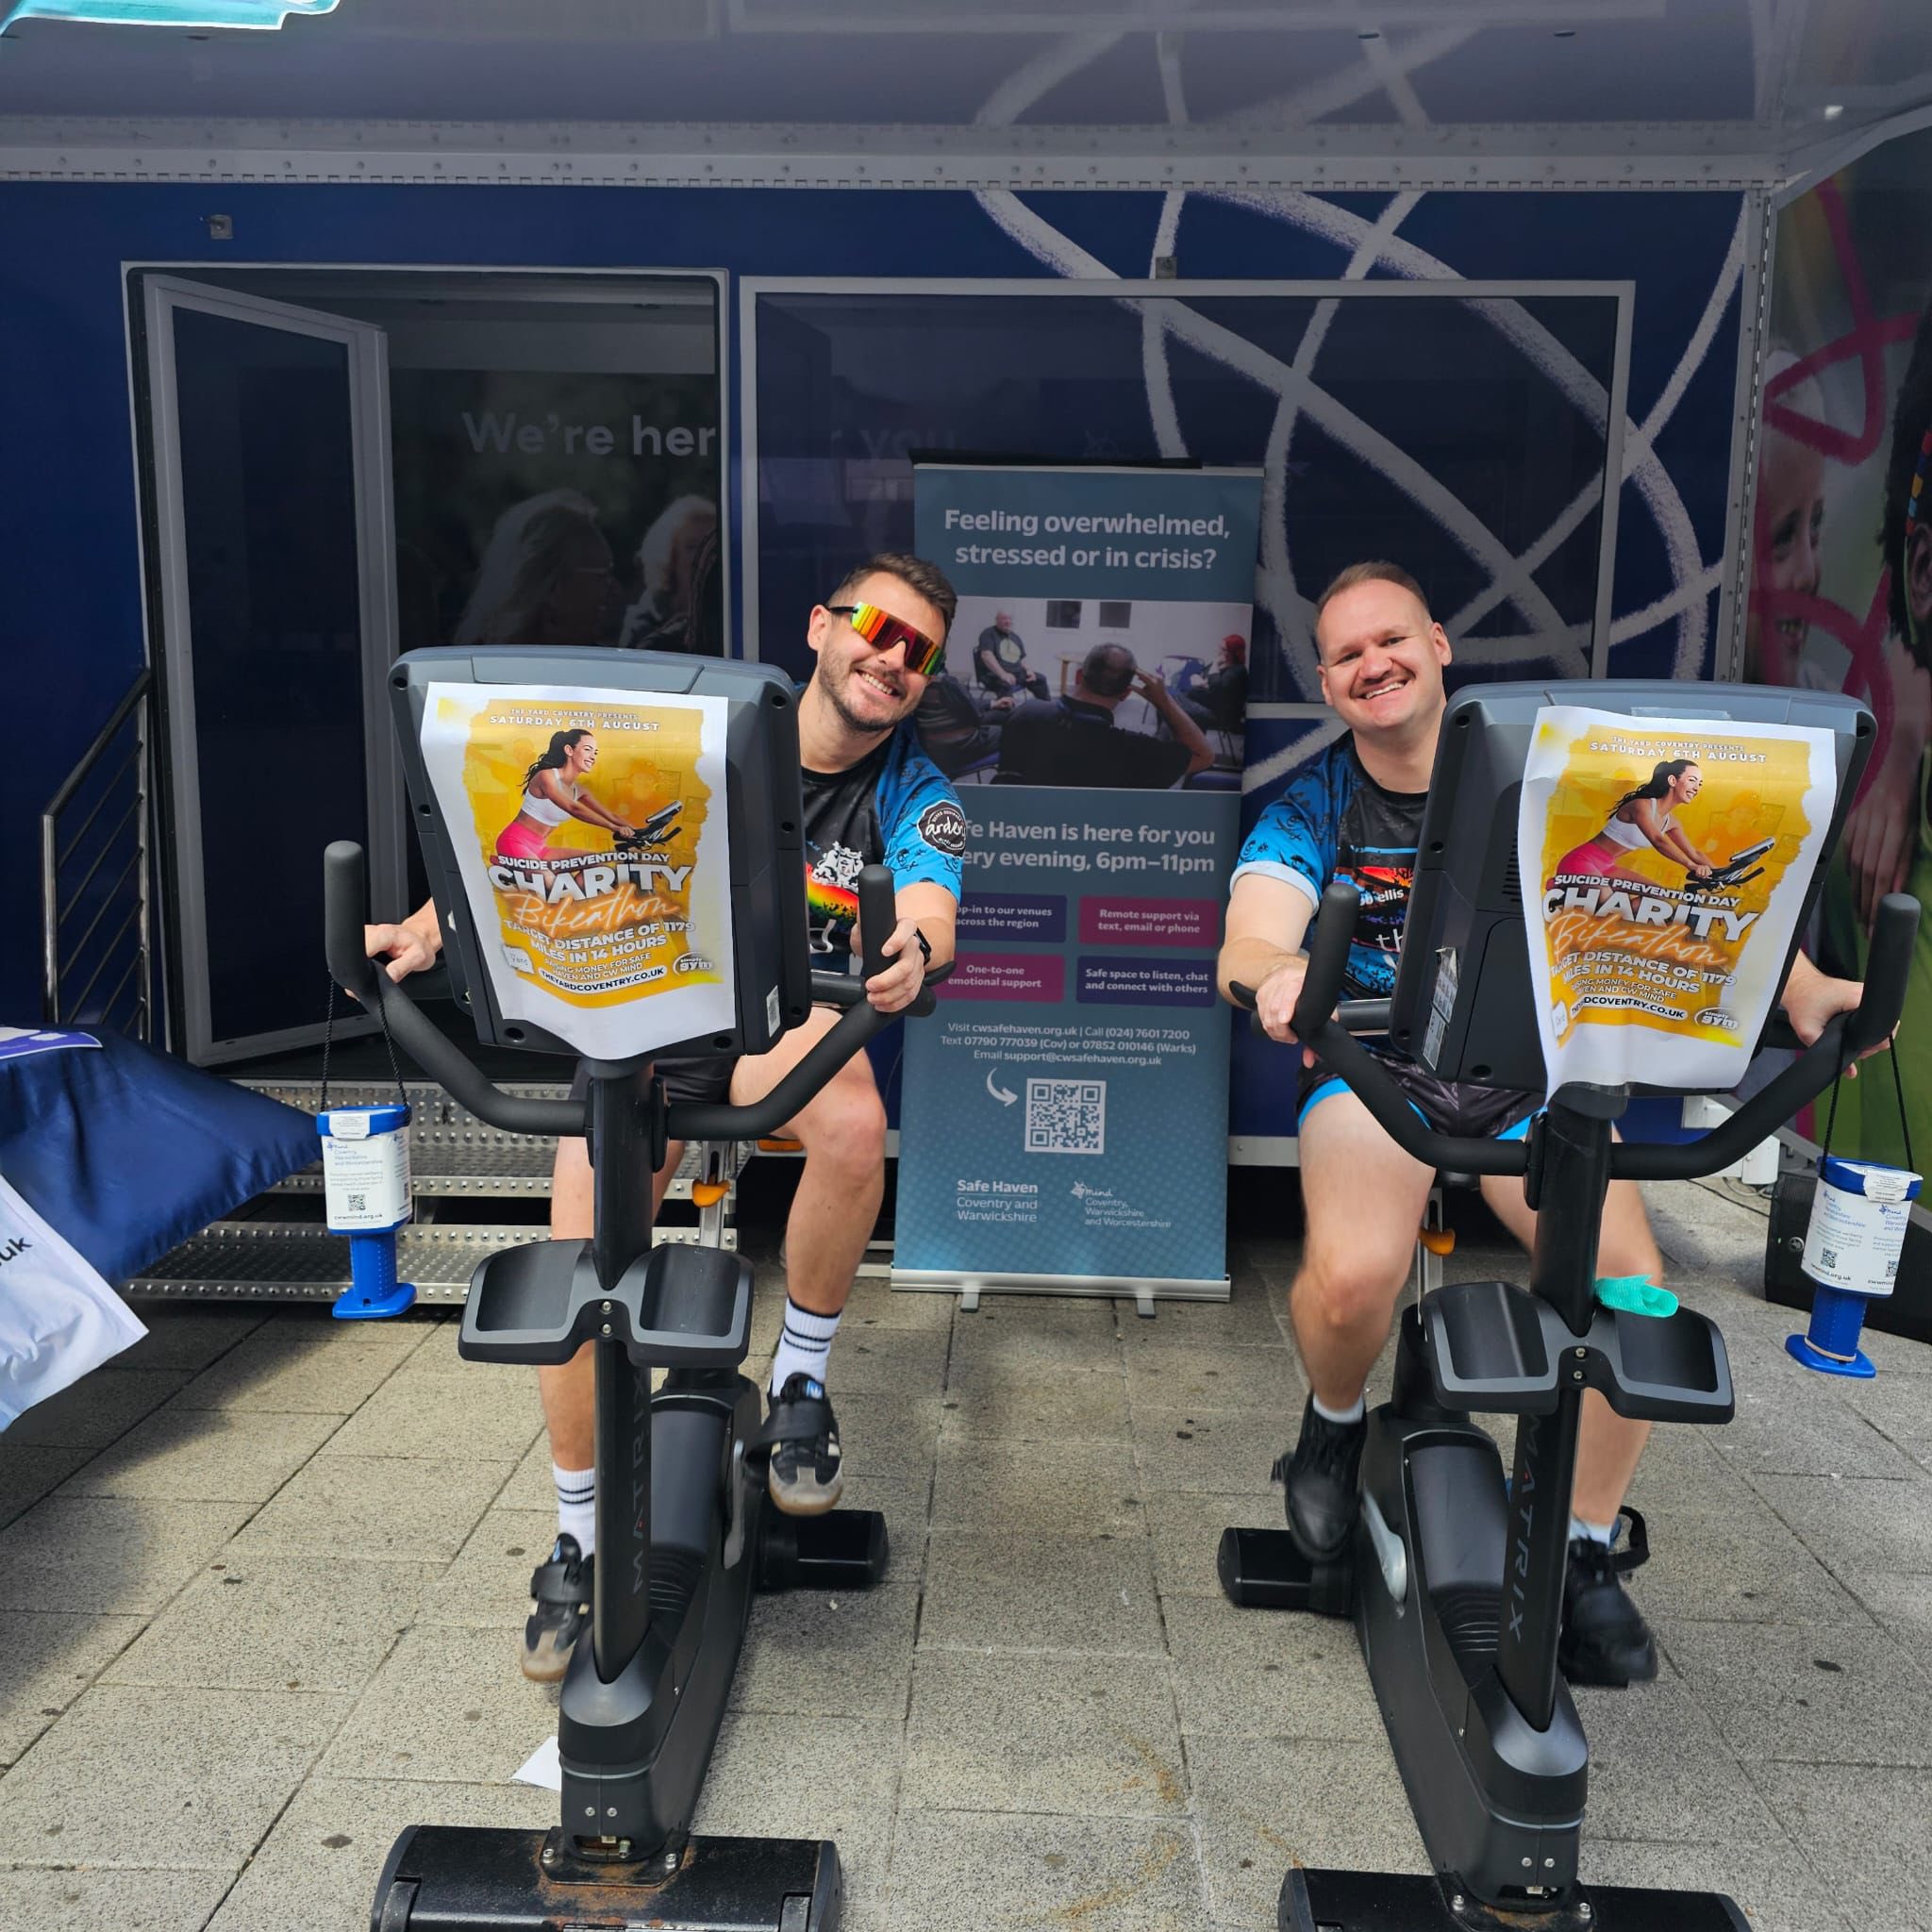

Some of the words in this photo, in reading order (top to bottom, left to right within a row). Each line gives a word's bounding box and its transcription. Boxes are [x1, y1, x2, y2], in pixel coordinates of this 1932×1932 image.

[633, 415, 716, 458] her
[944, 509, 1039, 536] Feeling
[1044, 511, 1230, 539] overwhelmed,
[956, 544, 1066, 566] stressed
[1072, 548, 1100, 566] or
[1106, 545, 1129, 566] in
[1135, 547, 1217, 570] crisis?
[490, 715, 562, 726] SATURDAY
[569, 719, 595, 728] 6TH
[603, 721, 659, 731] AUGUST
[1590, 741, 1666, 757] SATURDAY
[1674, 750, 1700, 758] 6TH
[1707, 753, 1767, 763] AUGUST
[1656, 741, 1700, 749] COVENTRY
[1703, 743, 1744, 752] PRESENTS
[966, 820, 983, 838] fe
[989, 821, 1057, 840] Haven
[1060, 823, 1079, 841] is
[1083, 824, 1132, 843] here
[1138, 824, 1172, 844] for
[1174, 830, 1215, 848] you
[498, 856, 549, 870] SUICIDE
[551, 852, 639, 870] PREVENTION
[641, 853, 671, 862] DAY
[963, 851, 995, 869] ery
[1000, 851, 1091, 872] evening,
[488, 863, 694, 904] CHARITY
[1555, 874, 1610, 887] SUICIDE
[1612, 878, 1705, 903] PREVENTION
[1707, 896, 1740, 908] DAY
[1377, 889, 1404, 902] ellis
[957, 905, 981, 915] op-in
[985, 906, 995, 914] to
[1017, 908, 1053, 916] venues
[1100, 908, 1140, 919] Remote
[1141, 910, 1181, 922] support
[1184, 911, 1199, 922] via
[1542, 886, 1759, 941] CHARITY
[988, 917, 1005, 926] the
[1007, 918, 1039, 929] region
[1098, 923, 1123, 932] text,
[1124, 923, 1152, 931] email
[1155, 924, 1165, 933] or
[1168, 924, 1200, 934] phone
[504, 920, 552, 944] TARGET
[556, 930, 635, 951] DISTANCE
[638, 923, 660, 936] OF
[663, 921, 695, 932] 1179
[530, 940, 566, 962] MILES
[569, 950, 588, 963] IN
[591, 947, 608, 959] 14
[612, 935, 667, 956] HOURS
[575, 963, 608, 974] MONEY
[609, 958, 628, 968] FOR
[629, 953, 652, 963] SAFE
[580, 972, 601, 981] AND
[603, 969, 618, 977] CW
[620, 962, 642, 973] MIND
[679, 961, 714, 973] gym
[966, 965, 1024, 974] One-to-one
[1584, 950, 1670, 974] DISTANCE
[1673, 966, 1701, 979] OF
[1701, 972, 1737, 987] 1179
[948, 976, 999, 986] emotional
[1002, 978, 1041, 989] support
[1086, 968, 1108, 978] Safe
[1109, 970, 1138, 980] space
[1140, 971, 1151, 979] to
[1152, 970, 1184, 981] listen,
[1186, 972, 1208, 981] chat
[1594, 964, 1613, 974] IN
[1618, 965, 1634, 976] 14
[1638, 970, 1700, 993] HOURS
[1085, 981, 1105, 990] and
[1107, 983, 1147, 991] connect
[1149, 982, 1174, 992] with
[1174, 983, 1208, 993] others
[1596, 978, 1629, 987] MONEY
[1631, 981, 1650, 991] FOR
[1652, 987, 1677, 999] SAFE
[1599, 985, 1619, 993] AND
[1621, 986, 1638, 995] CW
[1639, 991, 1665, 1003] MIND
[947, 1023, 970, 1033] Visit
[973, 1024, 1077, 1038] cwsafehaven.org.uk
[1086, 1025, 1104, 1037] Call
[1106, 1027, 1134, 1039] (024)
[1701, 1015, 1740, 1030] gym
[941, 1035, 962, 1045] Text
[964, 1036, 997, 1046] 07790
[999, 1037, 1038, 1047] 777039
[1040, 1038, 1067, 1050] (Cov)
[1069, 1041, 1081, 1049] or
[1083, 1040, 1116, 1050] 07852
[1118, 1041, 1155, 1051] 010146
[1157, 1042, 1196, 1055] (Warks)
[974, 1049, 1002, 1060] Email
[1004, 1050, 1161, 1066] support@cwsafehaven.org.uk
[957, 1179, 990, 1192] Safe
[992, 1180, 1038, 1193] Haven
[957, 1196, 1011, 1210] Coventry
[1015, 1199, 1038, 1209] and
[957, 1209, 1038, 1223] Warwickshire
[1086, 1208, 1144, 1218] Warwickshire
[1085, 1217, 1101, 1225] and
[1103, 1218, 1172, 1228] Worcestershire
